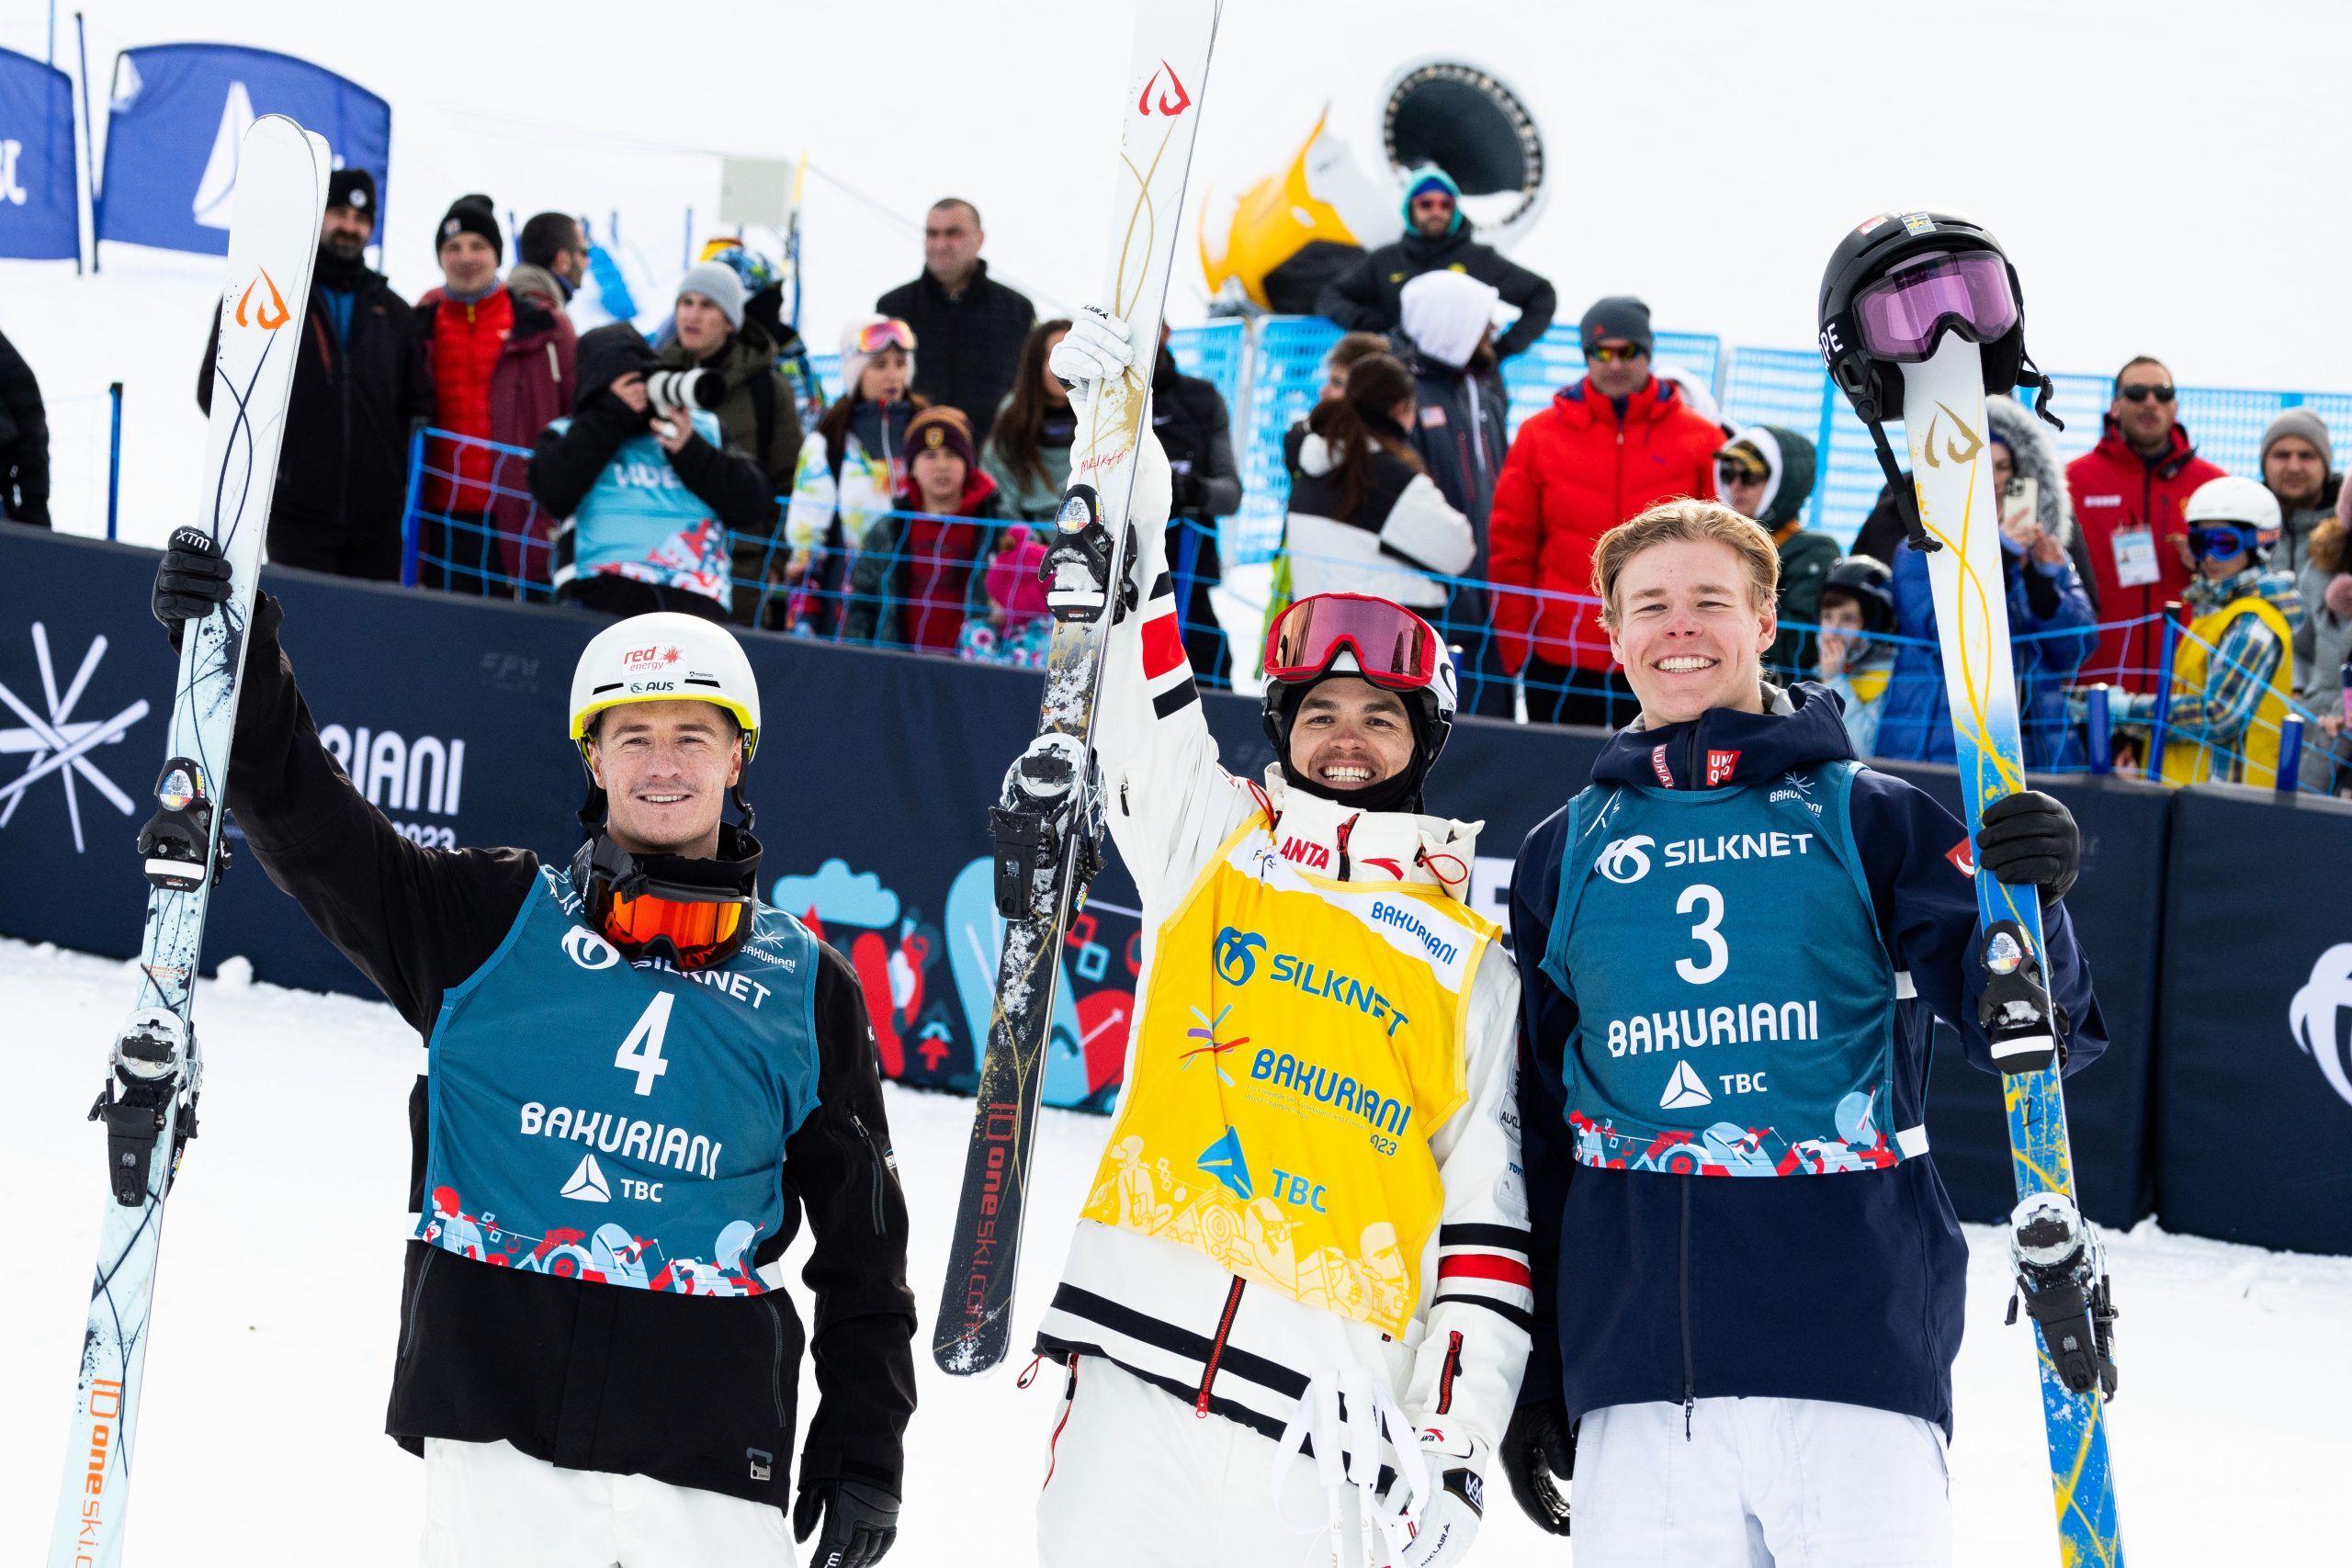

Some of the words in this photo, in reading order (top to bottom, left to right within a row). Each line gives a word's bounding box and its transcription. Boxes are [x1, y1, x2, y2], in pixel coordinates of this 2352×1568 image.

[175, 530, 210, 551] XTM
[624, 646, 657, 664] red
[629, 660, 664, 671] energy
[645, 682, 674, 692] AUS
[1770, 789, 1823, 814] BAKUANI
[1280, 836, 1329, 870] ANTA
[1664, 833, 1814, 868] SILKNET
[1372, 901, 1459, 965] BAKURIANI
[1674, 885, 1729, 986] 3
[1270, 954, 1409, 1037] SILKNET
[614, 990, 675, 1096] 4
[1608, 1000, 1818, 1058] BAKURIANI
[1244, 1093, 1263, 1103] World
[1250, 1048, 1412, 1137] BAKURIANI
[1719, 1072, 1769, 1095] TBC
[519, 1101, 723, 1179] BAKURIANI
[1369, 1133, 1398, 1156] 023
[620, 1179, 663, 1203] TBC
[1272, 1168, 1327, 1213] TBC
